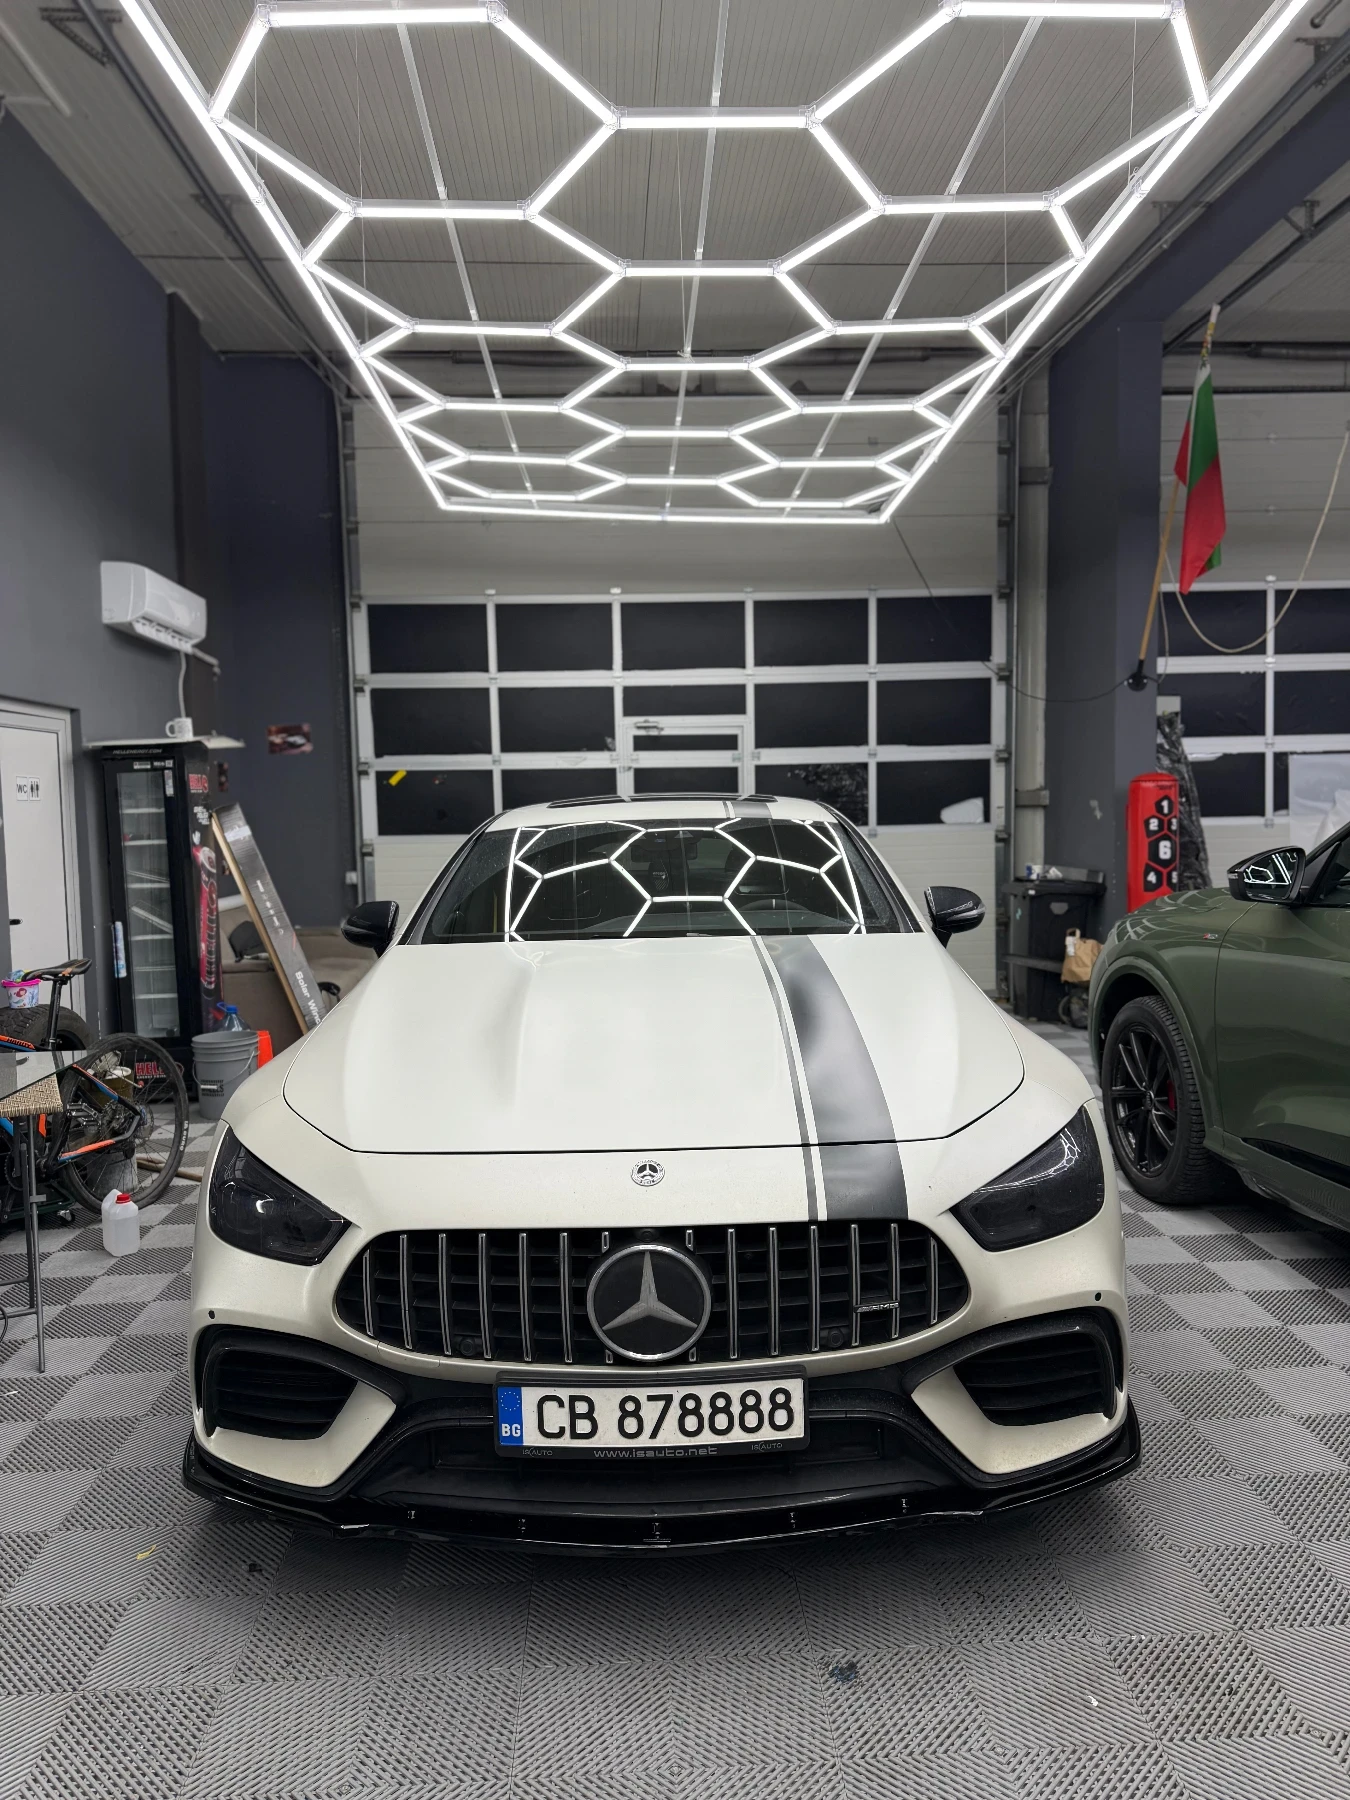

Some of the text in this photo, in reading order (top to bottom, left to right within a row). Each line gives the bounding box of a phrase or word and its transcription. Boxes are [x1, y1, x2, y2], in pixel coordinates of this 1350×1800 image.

[16, 784, 27, 793] WC
[1160, 799, 1170, 814] 1
[1148, 818, 1159, 831] 2
[1158, 840, 1172, 860] 6
[1146, 871, 1157, 884] 4
[295, 971, 311, 998] Solar
[537, 1387, 794, 1439] CB 878888
[501, 1423, 521, 1437] BG
[593, 1446, 718, 1458] www.isauto.net
